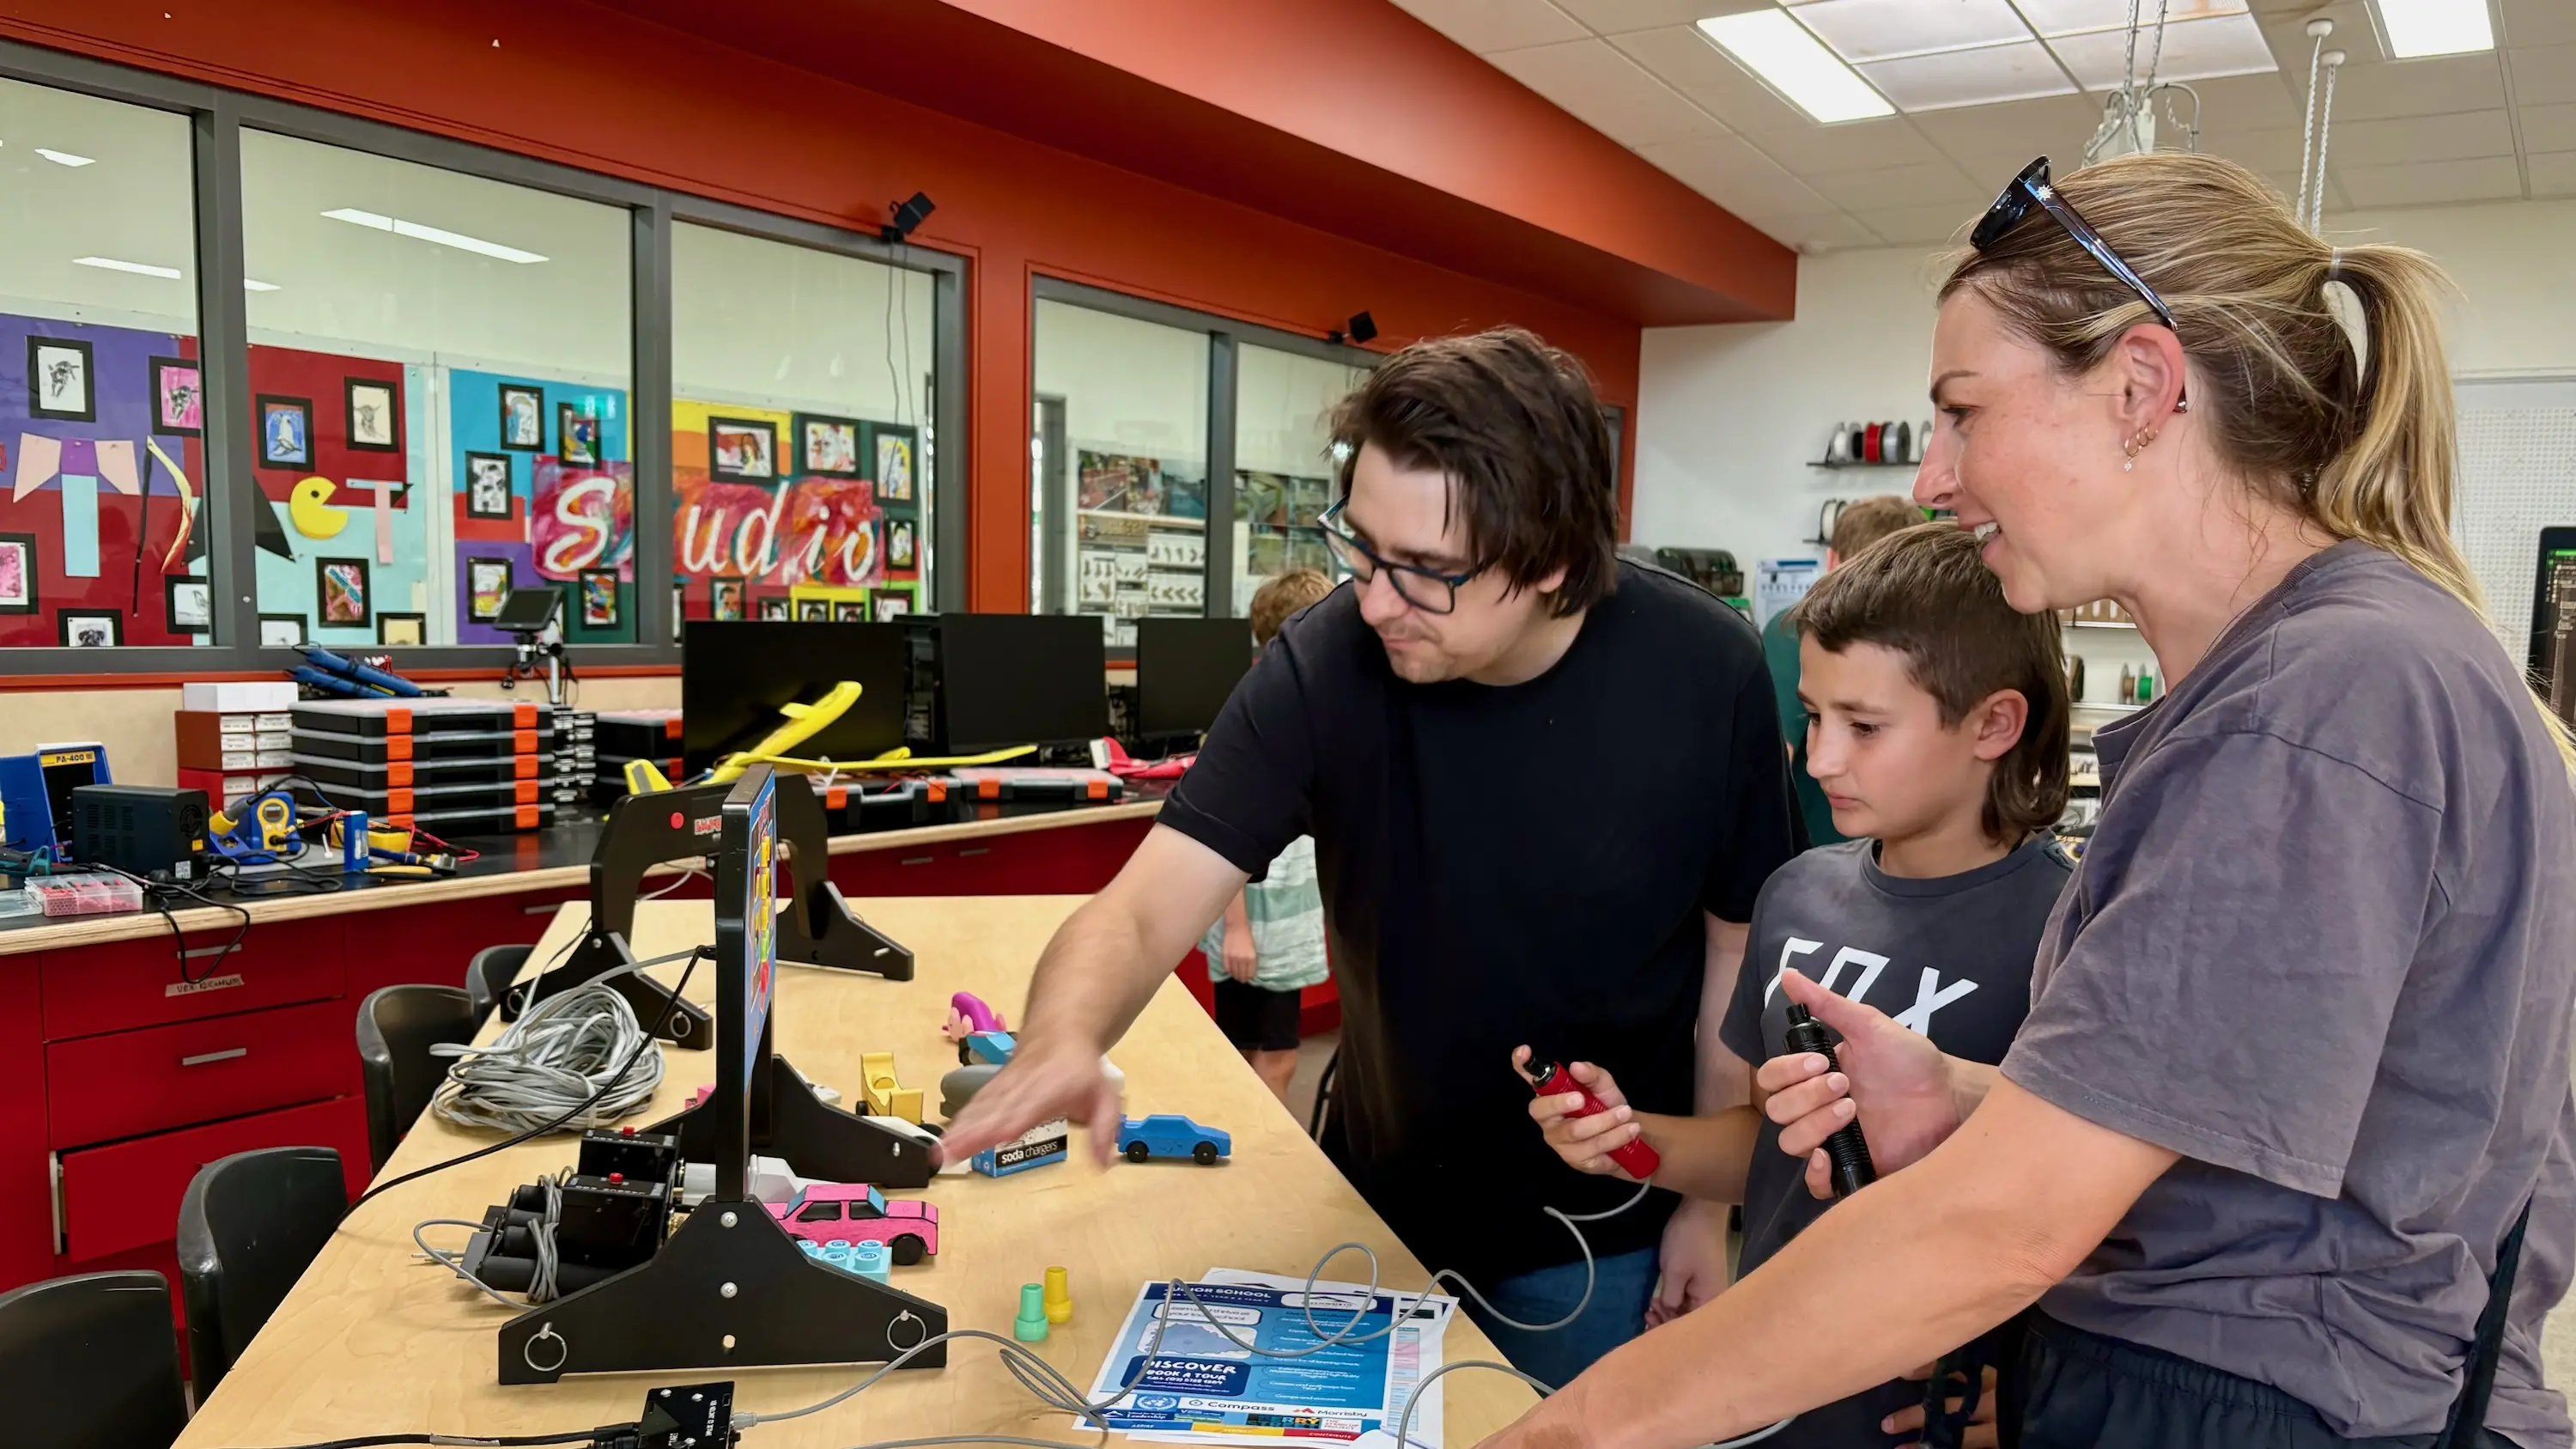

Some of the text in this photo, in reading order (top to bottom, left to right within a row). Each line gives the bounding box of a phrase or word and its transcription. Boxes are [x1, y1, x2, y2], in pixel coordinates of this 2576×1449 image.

[544, 477, 876, 586] Sudio
[1765, 936, 1978, 1037] FOX
[1001, 1141, 1058, 1164] soda chargers
[1216, 1288, 1271, 1299] SCHOOL
[1207, 1401, 1275, 1411] Compass
[1317, 1409, 1367, 1418] Morrisby
